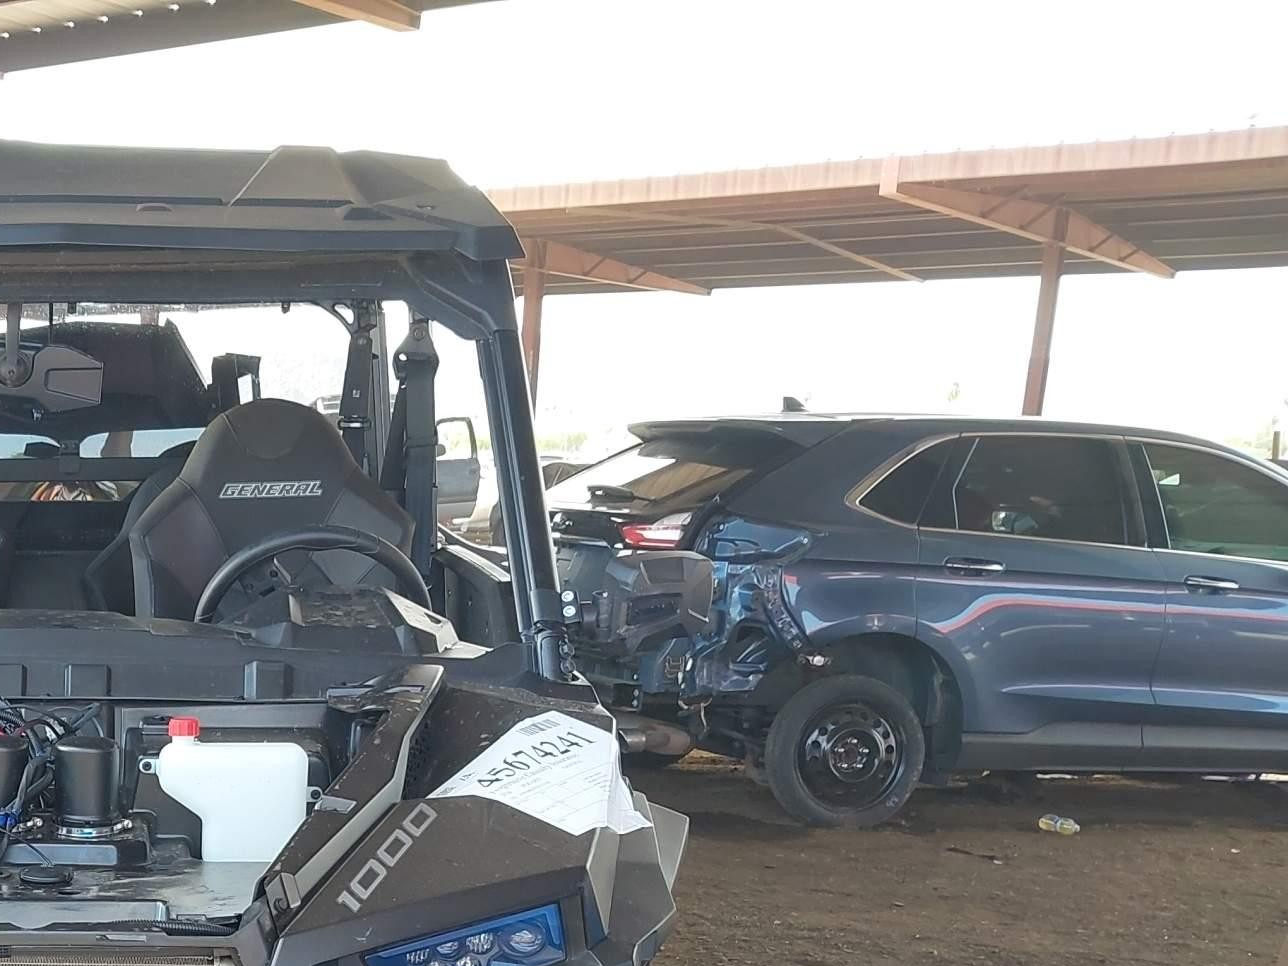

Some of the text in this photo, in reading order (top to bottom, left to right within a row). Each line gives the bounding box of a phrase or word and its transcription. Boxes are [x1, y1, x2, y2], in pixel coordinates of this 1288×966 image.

[219, 481, 322, 498] GENERAL
[477, 731, 597, 788] 45674241
[336, 802, 438, 912] 1000
